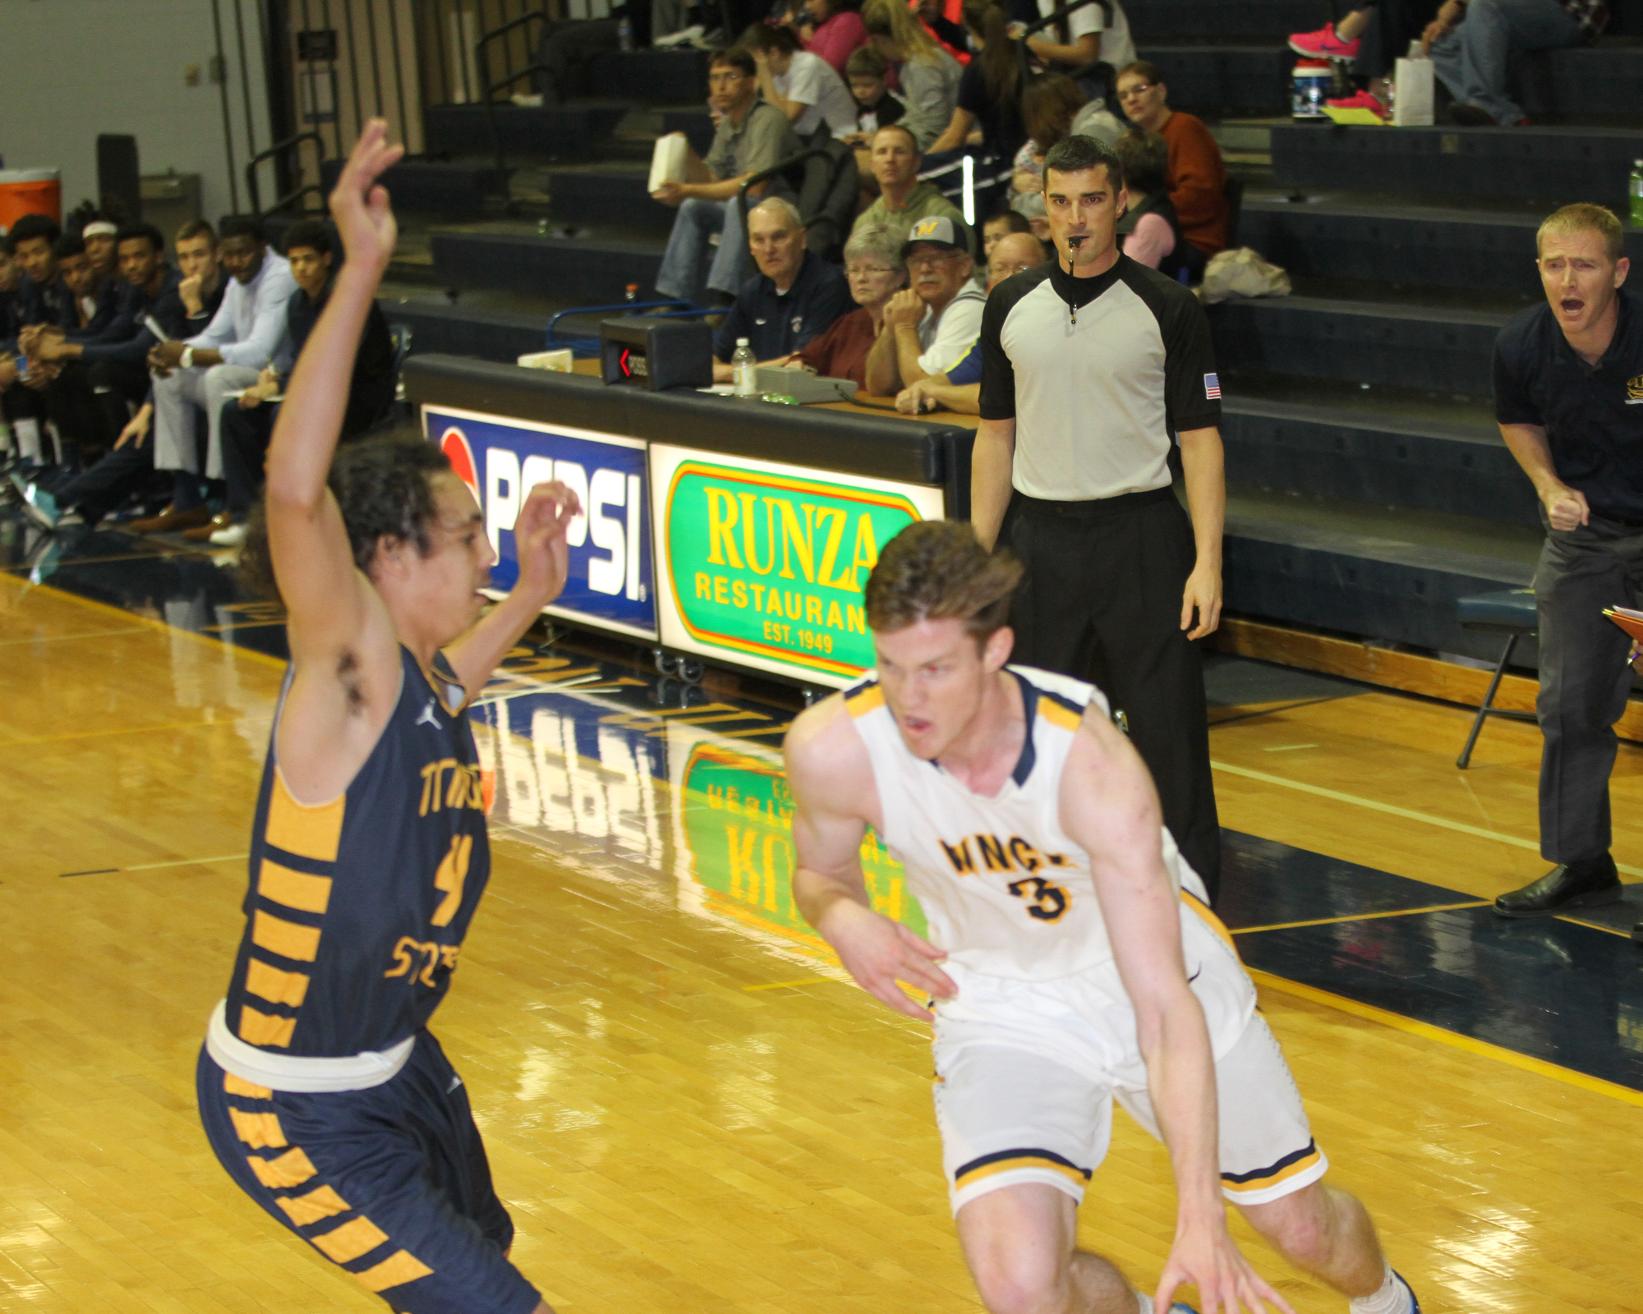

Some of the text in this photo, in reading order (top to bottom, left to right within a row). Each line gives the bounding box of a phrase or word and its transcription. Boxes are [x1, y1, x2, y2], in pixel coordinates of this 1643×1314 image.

[704, 486, 878, 593] RUNZA
[695, 571, 867, 635] RESTAURAN
[763, 620, 834, 654] EST. 1949
[1007, 876, 1073, 926] 3
